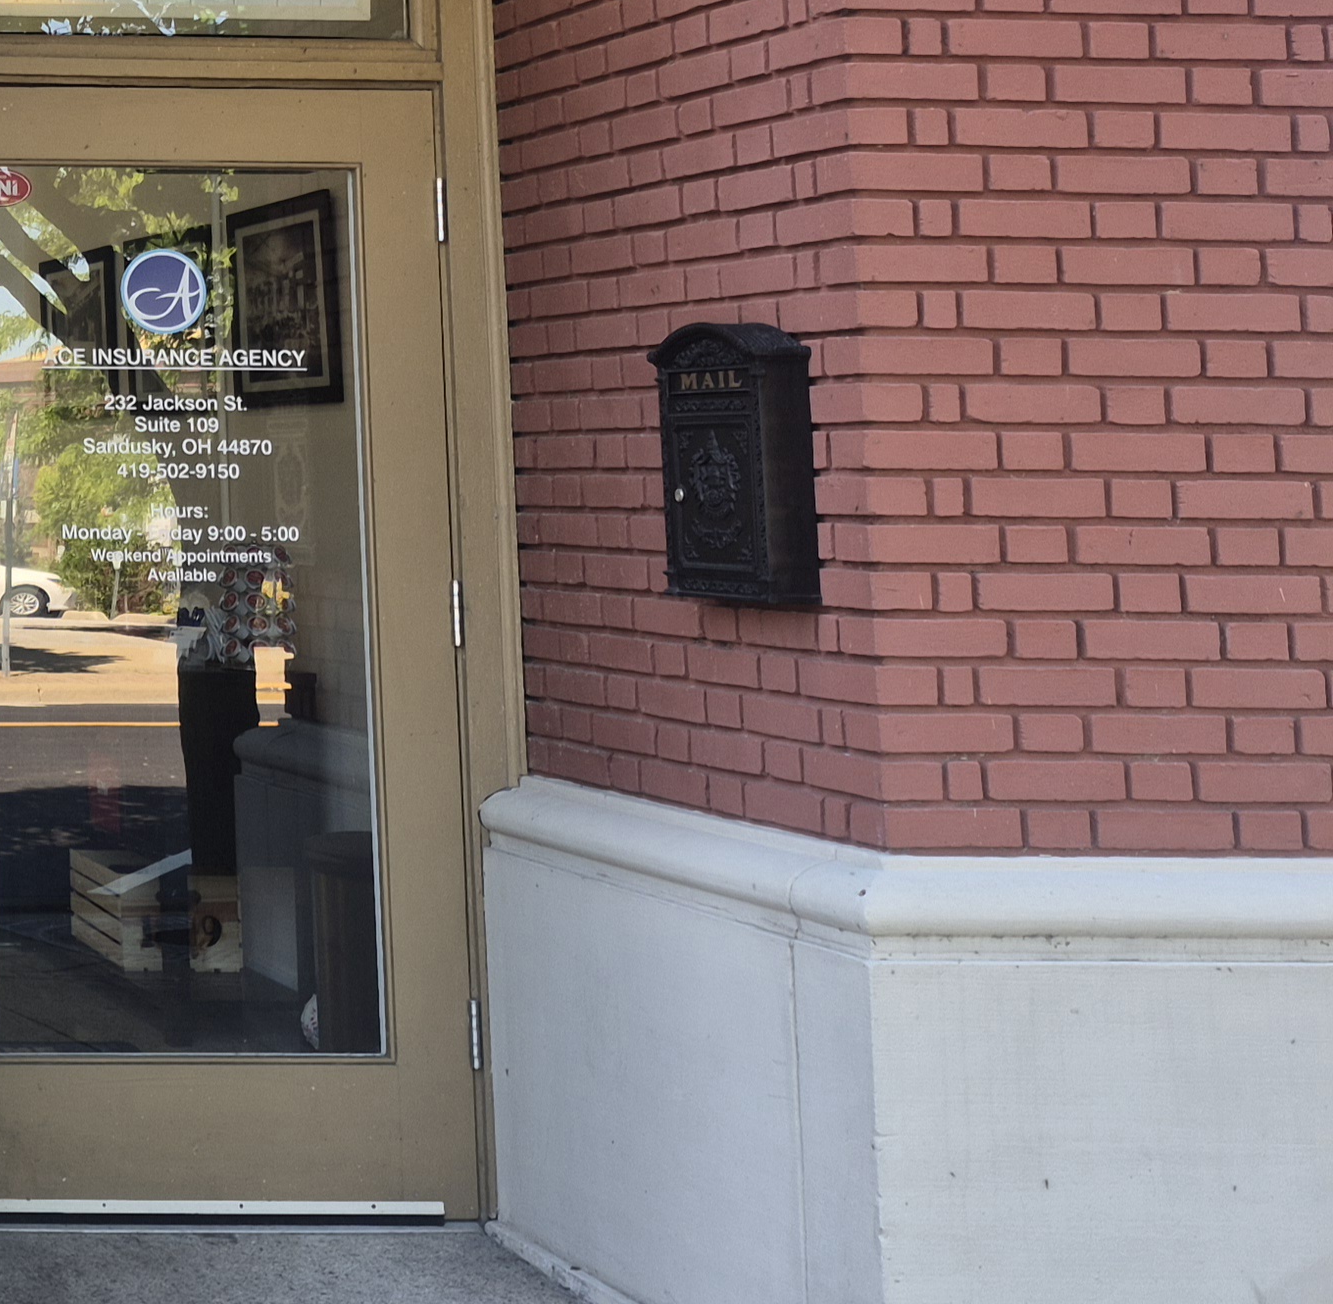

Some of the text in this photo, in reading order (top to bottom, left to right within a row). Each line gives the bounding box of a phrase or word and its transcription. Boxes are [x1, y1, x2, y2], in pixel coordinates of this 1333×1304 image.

[44, 349, 306, 367] ACE INSURANCE AGENCY
[680, 370, 742, 390] MAIL
[104, 395, 248, 412] 232 Jackson St.
[134, 416, 219, 433] Suite 109
[83, 437, 273, 457] Sandusky, OH 44870
[116, 463, 240, 479] 419-502-9150
[150, 503, 209, 519] Hours:
[61, 525, 133, 544] Monday
[208, 525, 246, 542] 9:00
[261, 526, 299, 542] 5:00
[91, 548, 272, 566] Weekend Appointments
[148, 567, 217, 582] Available
